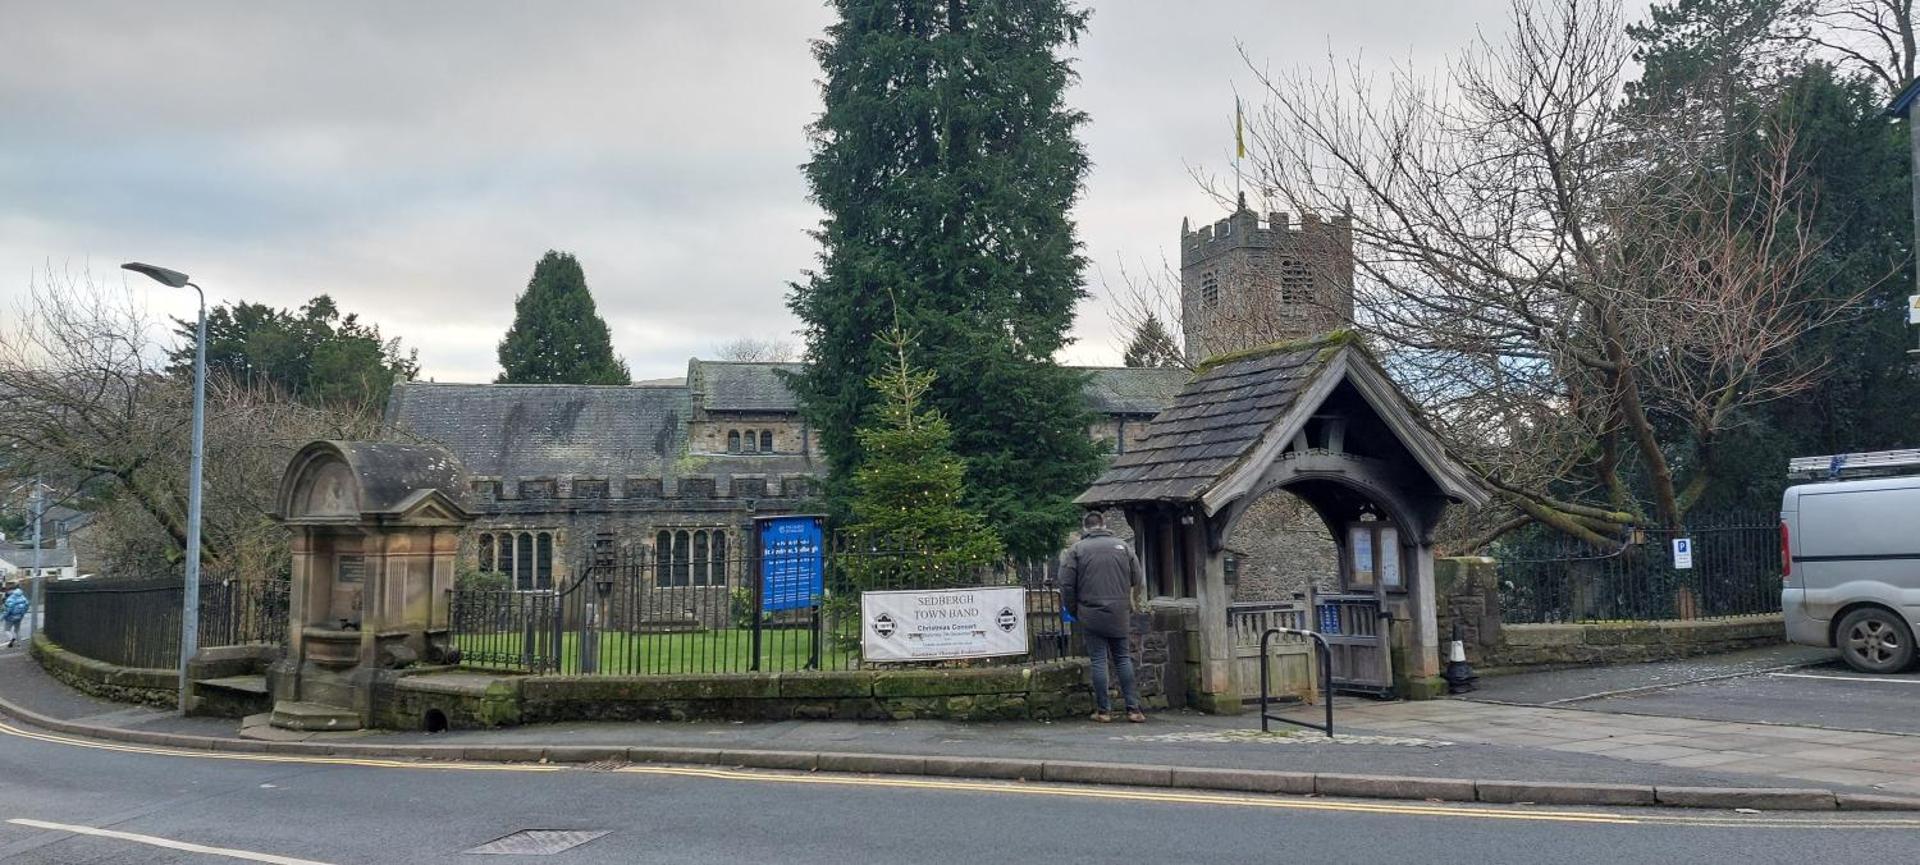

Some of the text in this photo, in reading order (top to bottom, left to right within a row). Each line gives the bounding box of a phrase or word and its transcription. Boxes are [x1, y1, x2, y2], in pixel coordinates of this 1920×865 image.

[918, 595, 974, 606] SEDBERGH
[914, 607, 979, 620] TOWN BAND
[917, 624, 951, 632] Christmas
